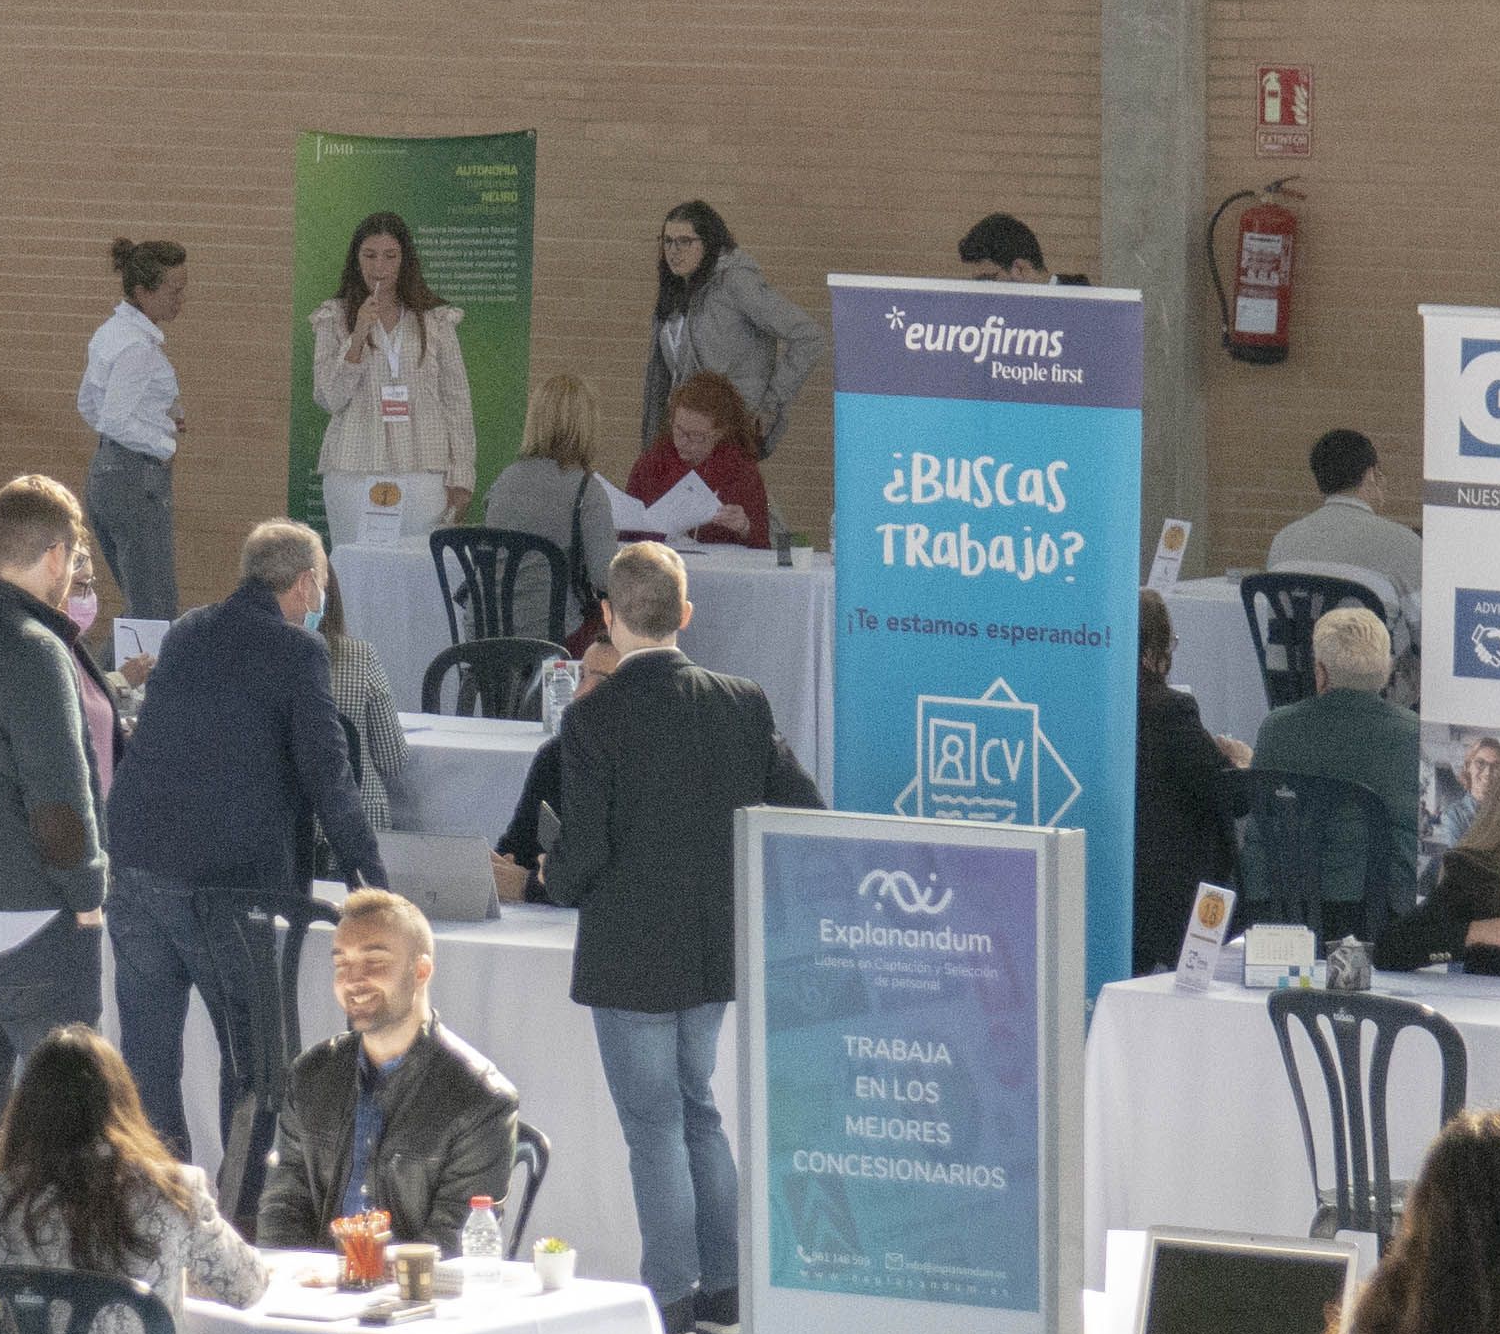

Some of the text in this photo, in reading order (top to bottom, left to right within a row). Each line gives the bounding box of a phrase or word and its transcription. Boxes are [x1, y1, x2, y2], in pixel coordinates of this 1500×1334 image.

[904, 316, 1064, 363] eurofirms
[991, 361, 1084, 385] People first
[846, 608, 1111, 649] ¡Te estamos esperando!
[981, 737, 1025, 785] CV
[819, 918, 993, 955] Explanandum
[843, 1034, 953, 1065] TRABAJA
[855, 1076, 940, 1103] EN LOS
[845, 1116, 951, 1144] MEJORES
[793, 1150, 1007, 1189] CONCESIONARIOS
